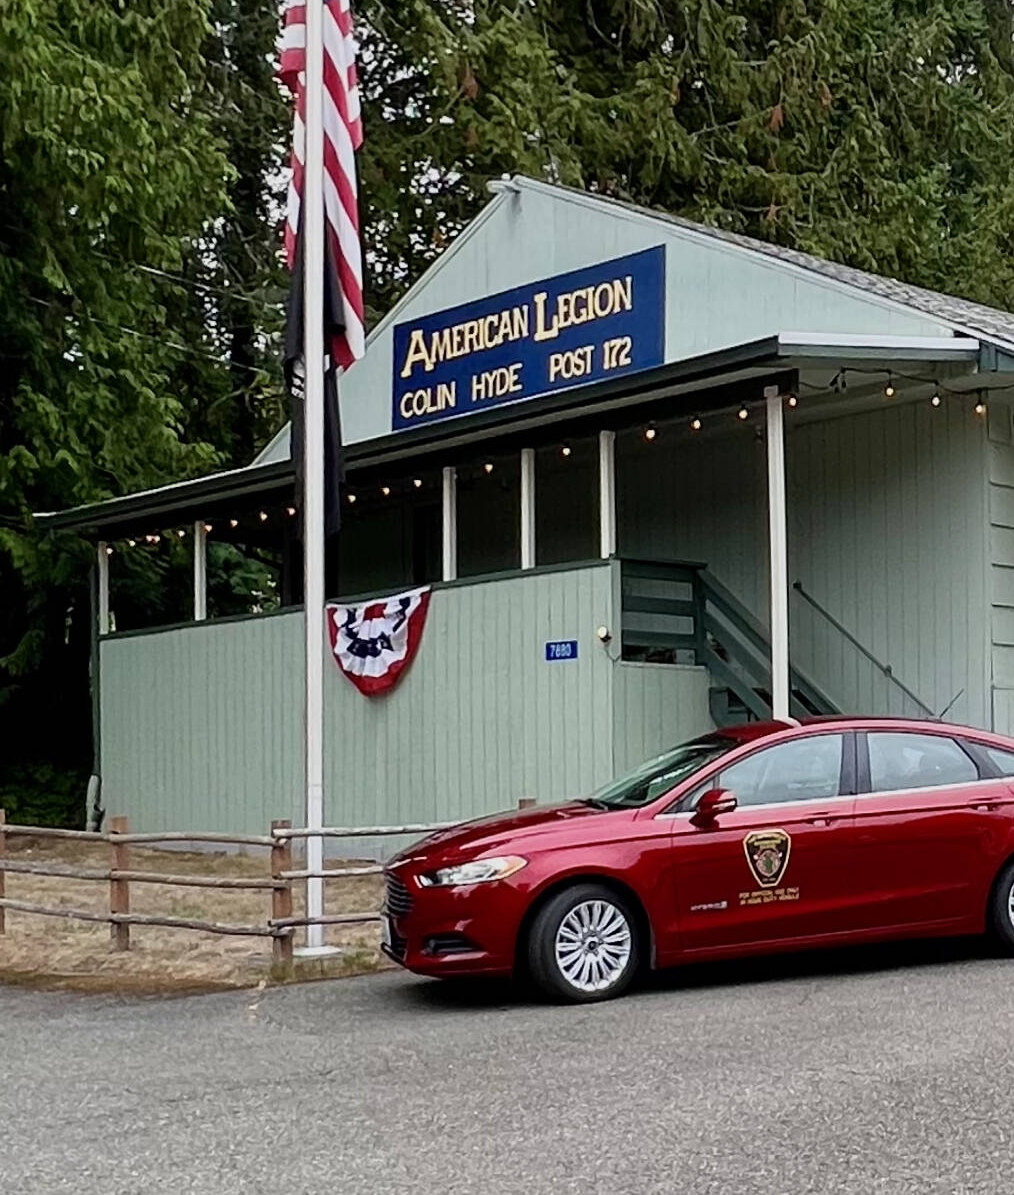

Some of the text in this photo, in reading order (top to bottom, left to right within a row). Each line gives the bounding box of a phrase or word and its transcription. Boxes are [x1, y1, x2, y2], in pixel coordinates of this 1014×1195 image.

[401, 276, 633, 378] AMERICAN LEGION
[400, 336, 632, 419] COLIN HYDE POST 172
